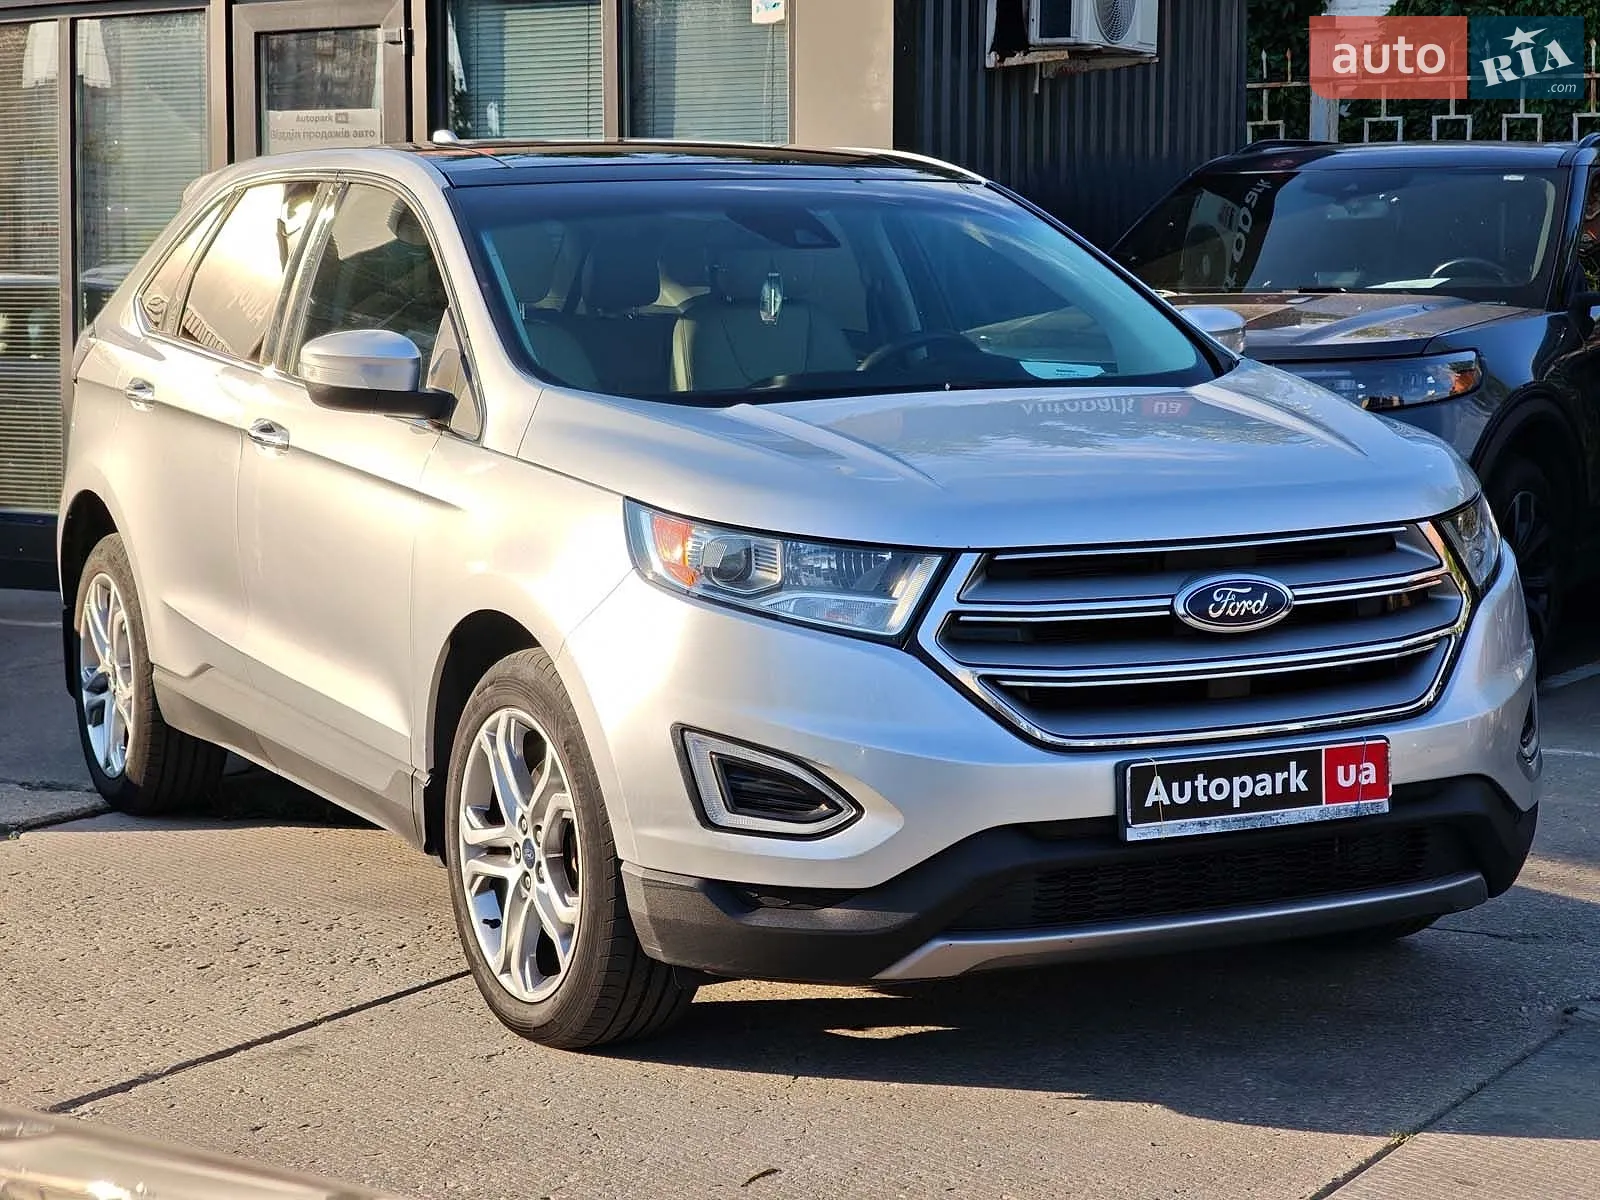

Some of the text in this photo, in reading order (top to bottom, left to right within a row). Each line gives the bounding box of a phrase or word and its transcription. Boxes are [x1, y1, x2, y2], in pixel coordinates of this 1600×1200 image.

[296, 113, 333, 123] Autopark
[352, 130, 376, 138] авто
[1208, 587, 1268, 618] Ford
[1144, 761, 1377, 808] Autopark ua
